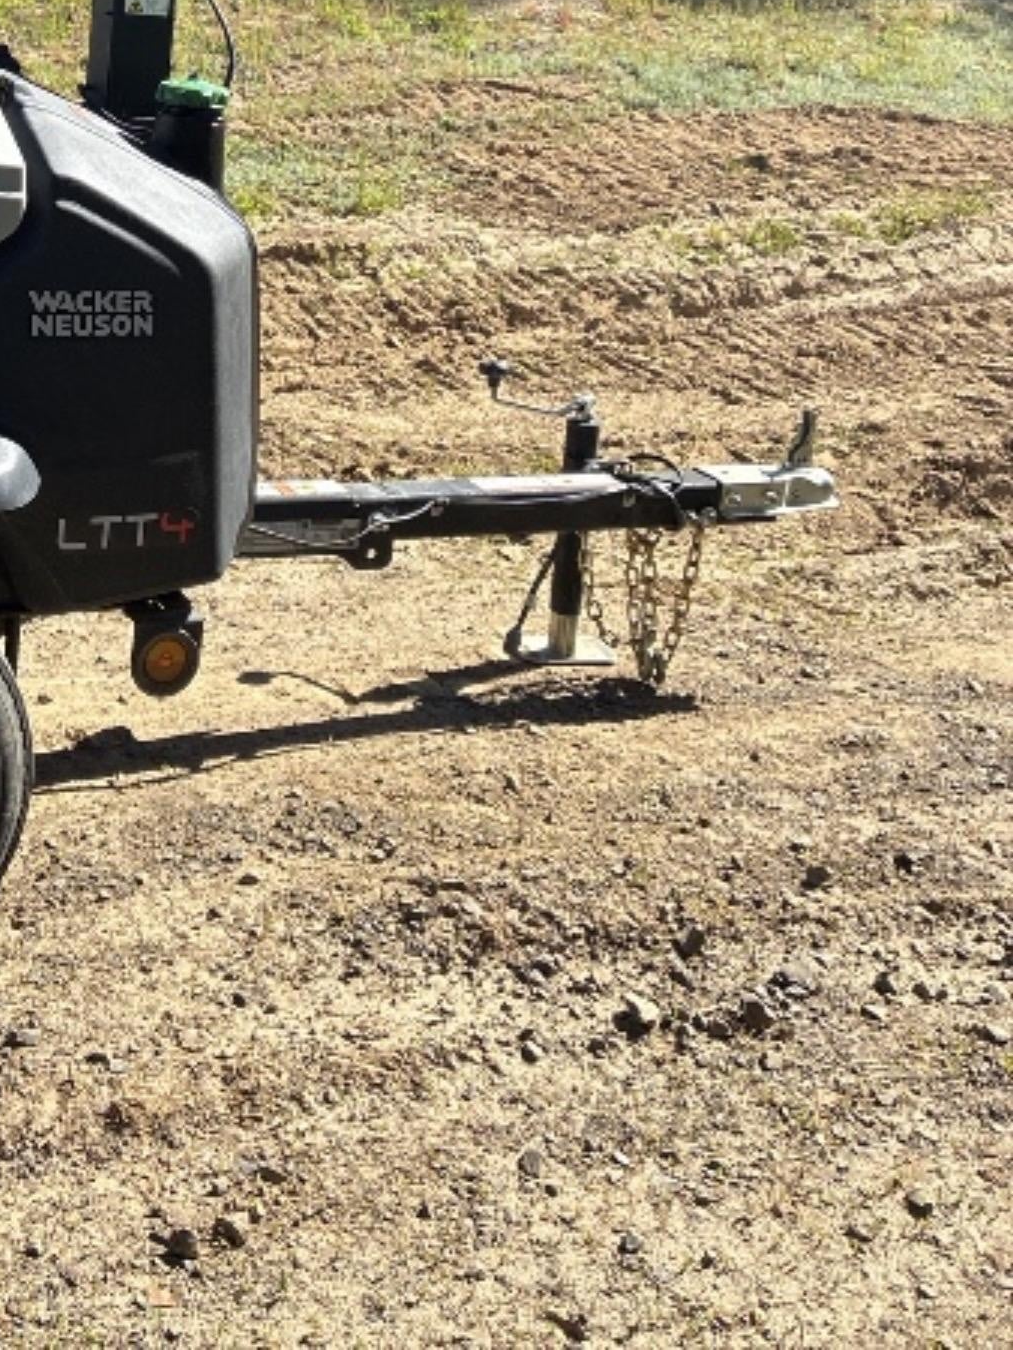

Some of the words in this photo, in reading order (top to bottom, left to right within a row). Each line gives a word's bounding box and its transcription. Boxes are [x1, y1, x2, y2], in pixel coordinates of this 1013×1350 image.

[27, 289, 154, 314] WACKER
[30, 313, 154, 338] NEUSON
[57, 511, 196, 551] LTT4
